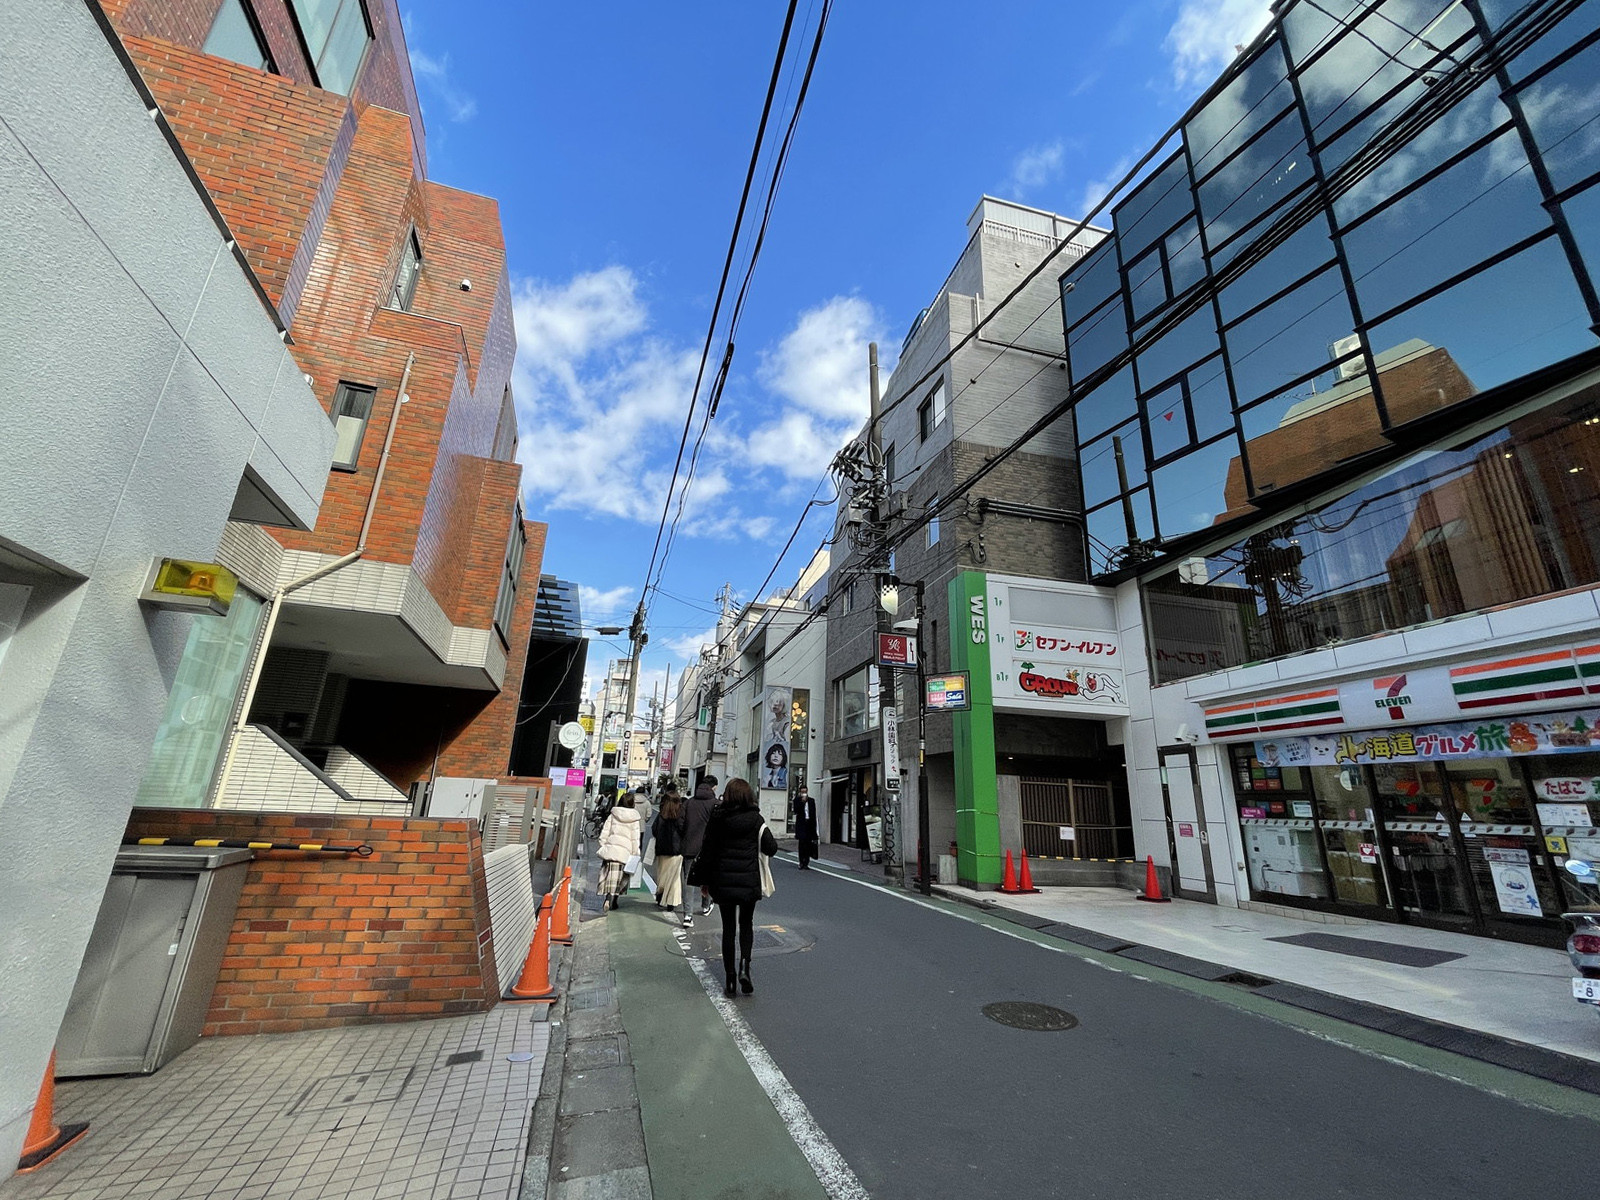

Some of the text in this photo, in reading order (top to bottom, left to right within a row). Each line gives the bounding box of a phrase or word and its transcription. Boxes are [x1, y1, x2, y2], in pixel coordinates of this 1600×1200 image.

[970, 595, 986, 645] WES
[1334, 723, 1511, 764] 北海道グルメ旅
[1544, 781, 1586, 795] たばこ
